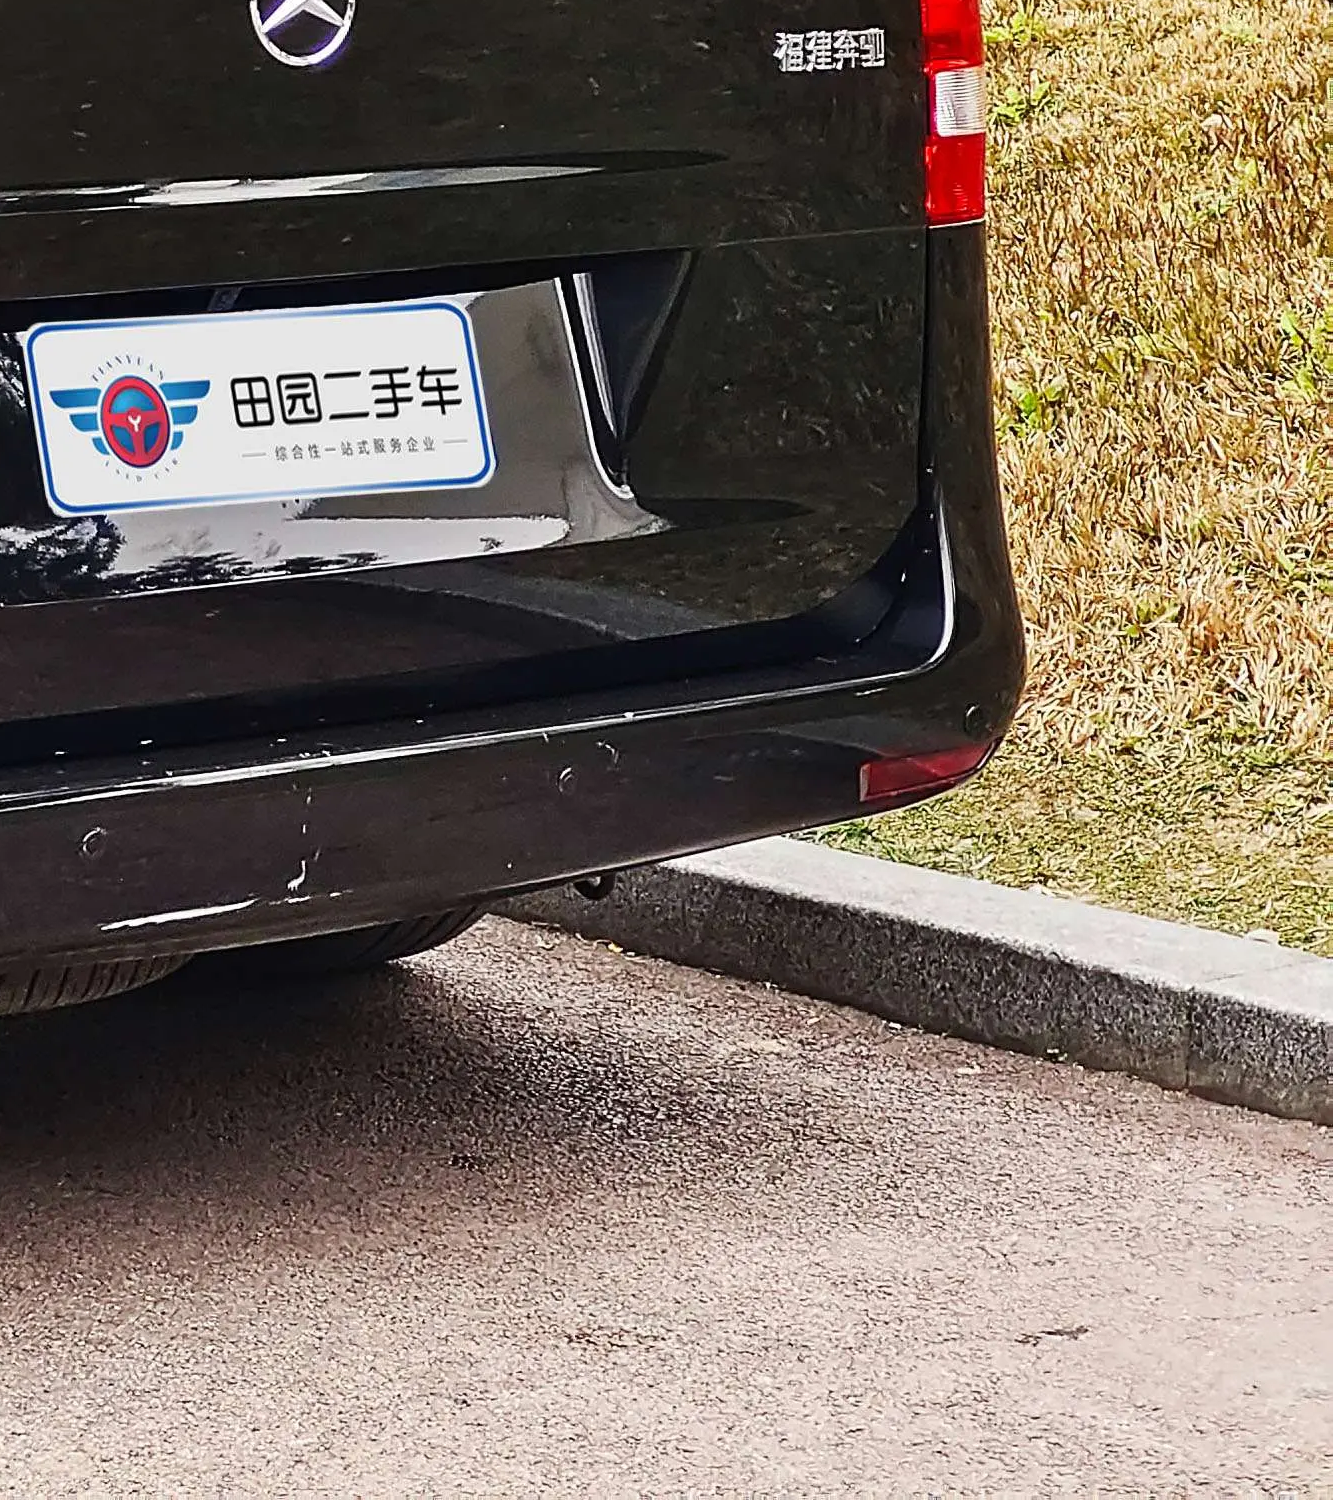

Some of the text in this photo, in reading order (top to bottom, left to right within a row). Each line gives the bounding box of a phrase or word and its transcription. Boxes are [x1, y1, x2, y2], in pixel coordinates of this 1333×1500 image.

[230, 365, 463, 428] 田园二手车
[274, 436, 436, 463] 综合性一站式服务企业
